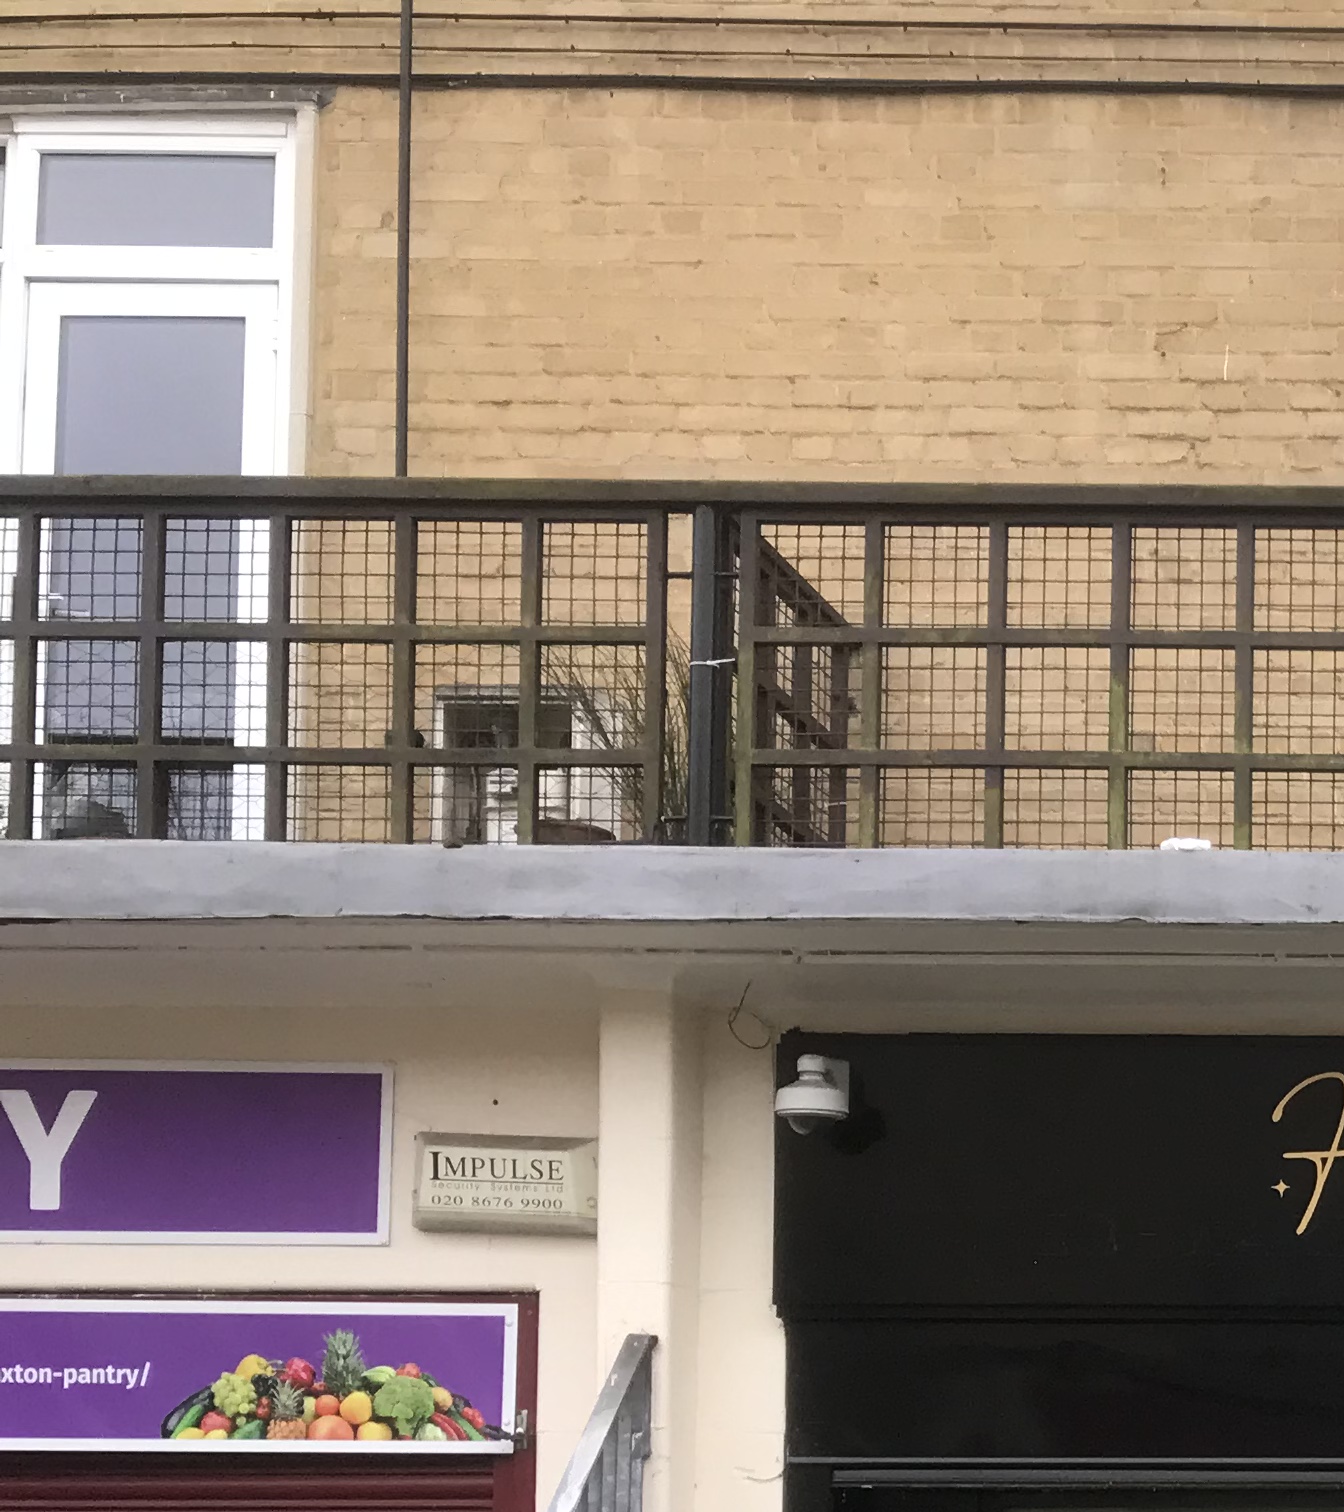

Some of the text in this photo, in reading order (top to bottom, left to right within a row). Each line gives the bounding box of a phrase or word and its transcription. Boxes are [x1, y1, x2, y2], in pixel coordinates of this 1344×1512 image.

[0, 1089, 98, 1211] Y
[429, 1151, 565, 1181] IMPULSE
[431, 1181, 564, 1193] Security Systems Ltd
[431, 1194, 563, 1210] 020 8676 9900
[0, 1361, 151, 1390] xton-pantry/
